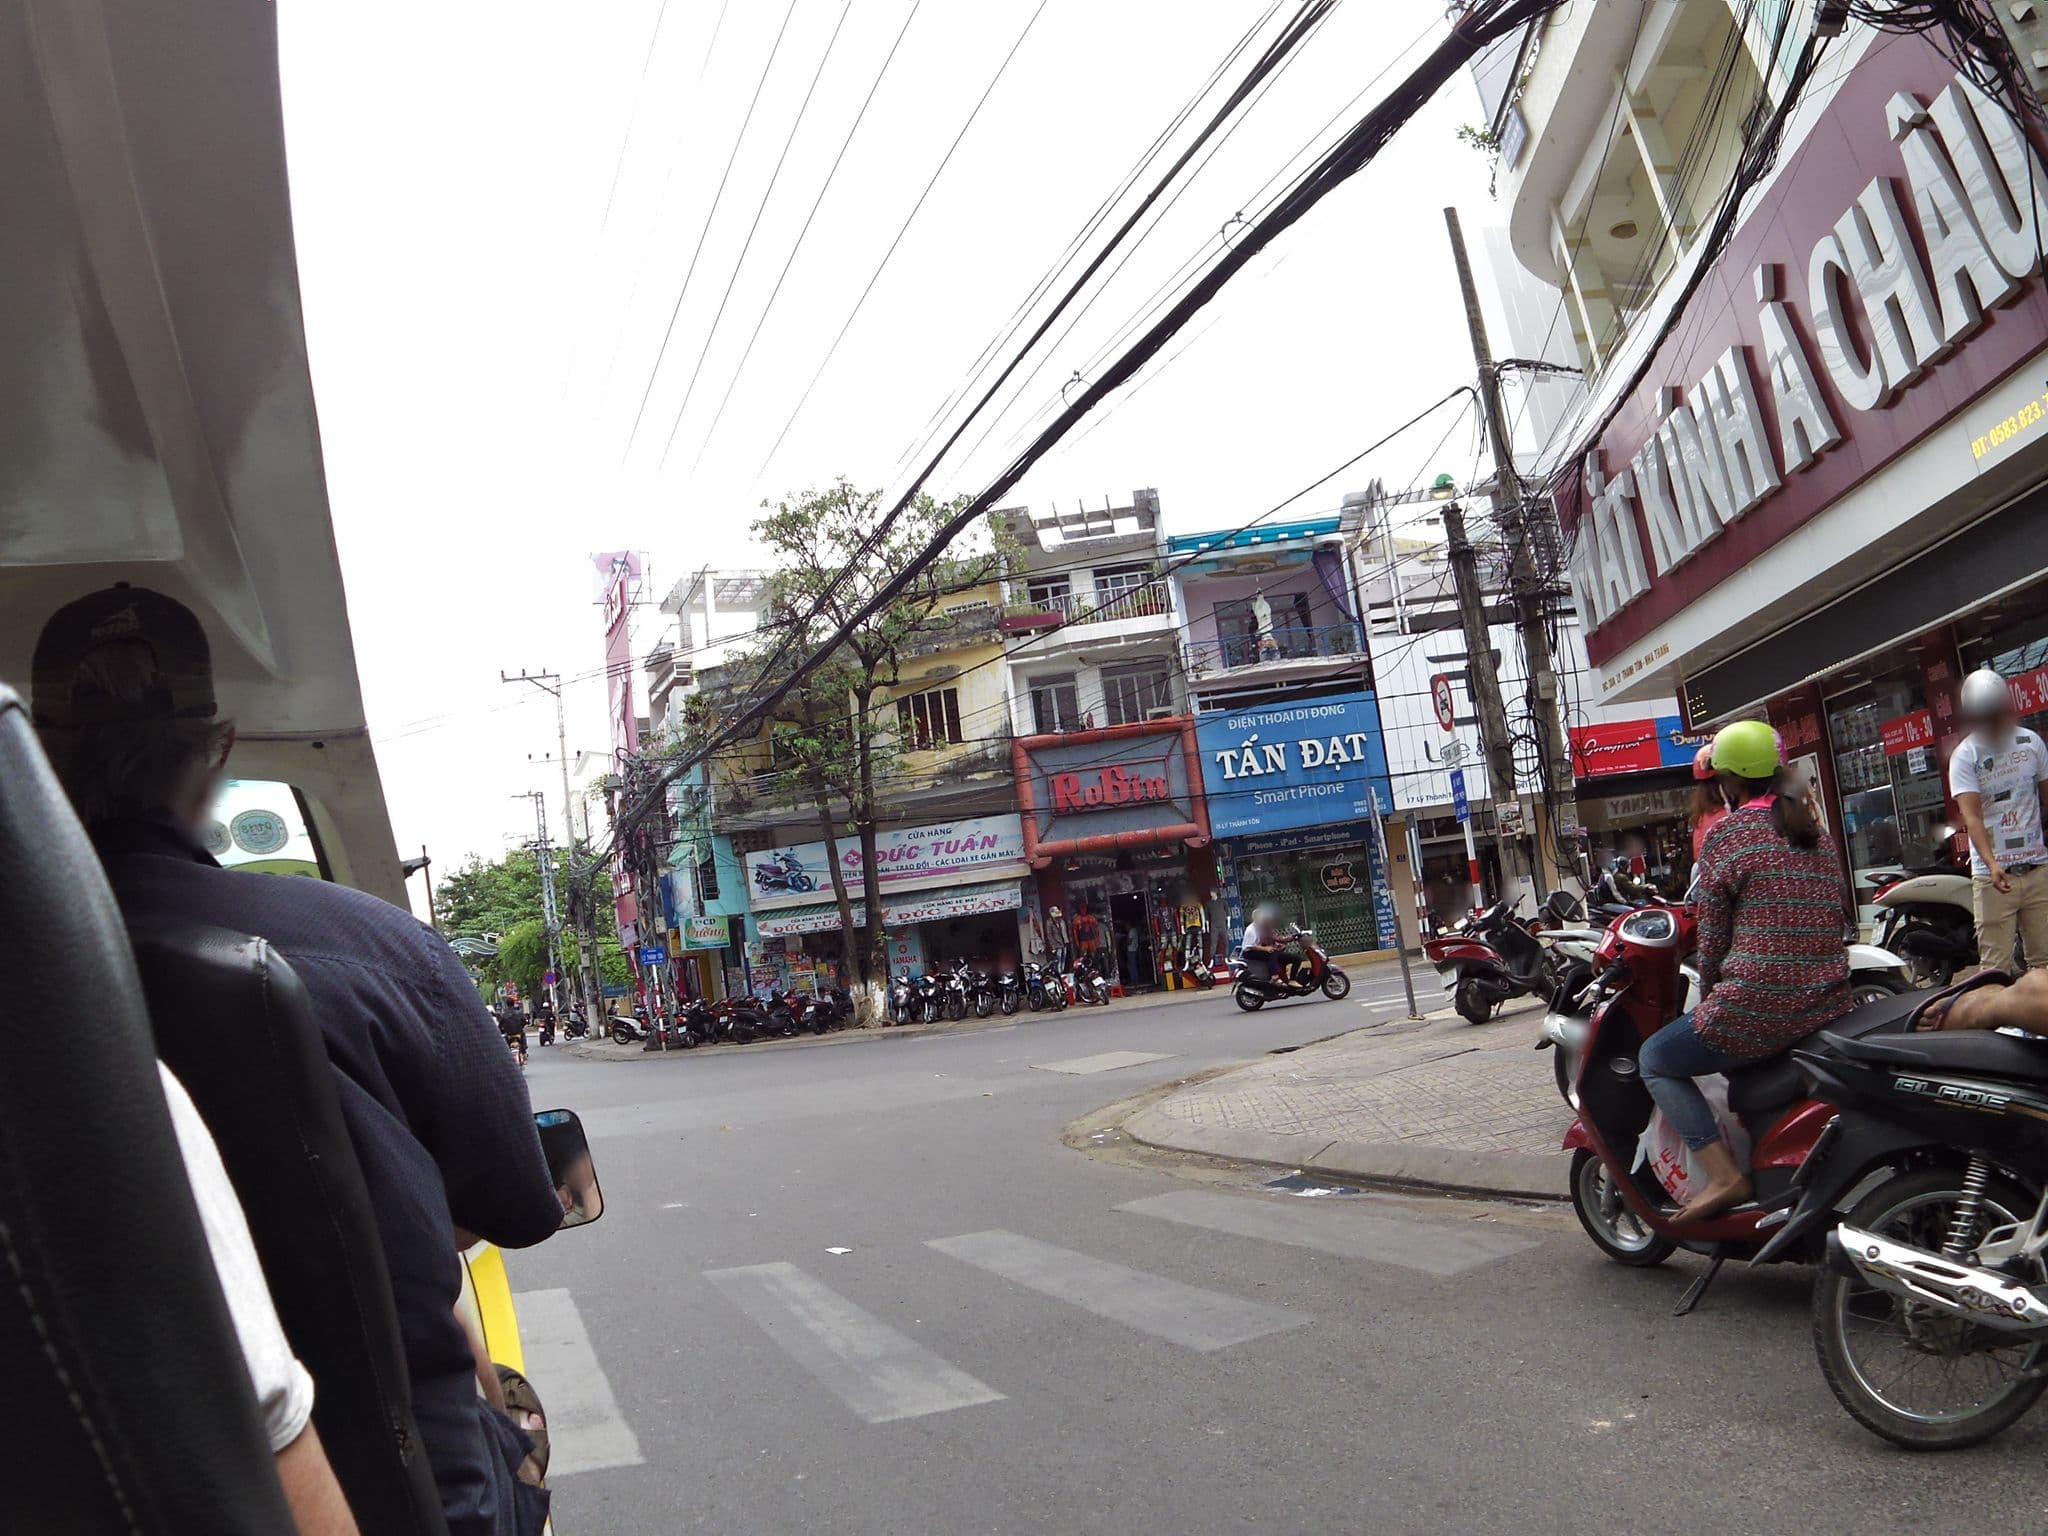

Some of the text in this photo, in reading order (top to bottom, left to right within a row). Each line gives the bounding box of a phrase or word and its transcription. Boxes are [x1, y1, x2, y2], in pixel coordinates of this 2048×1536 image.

[1569, 449, 1651, 637] MẮT
[1639, 385, 1782, 577] KÍNH
[1757, 263, 1842, 475] Á
[1228, 716, 1256, 731] ĐIỆN
[1258, 711, 1295, 727] THOẠI
[1296, 709, 1309, 720] DI
[1215, 732, 1368, 780] TẤN ĐẠT
[1254, 782, 1345, 805] Smart Phone
[874, 830, 999, 865] ĐỨC TUẤN
[896, 907, 941, 920] ĐỨC
[947, 898, 1006, 914] TUẤN
[1893, 1077, 2011, 1111] BLADE
